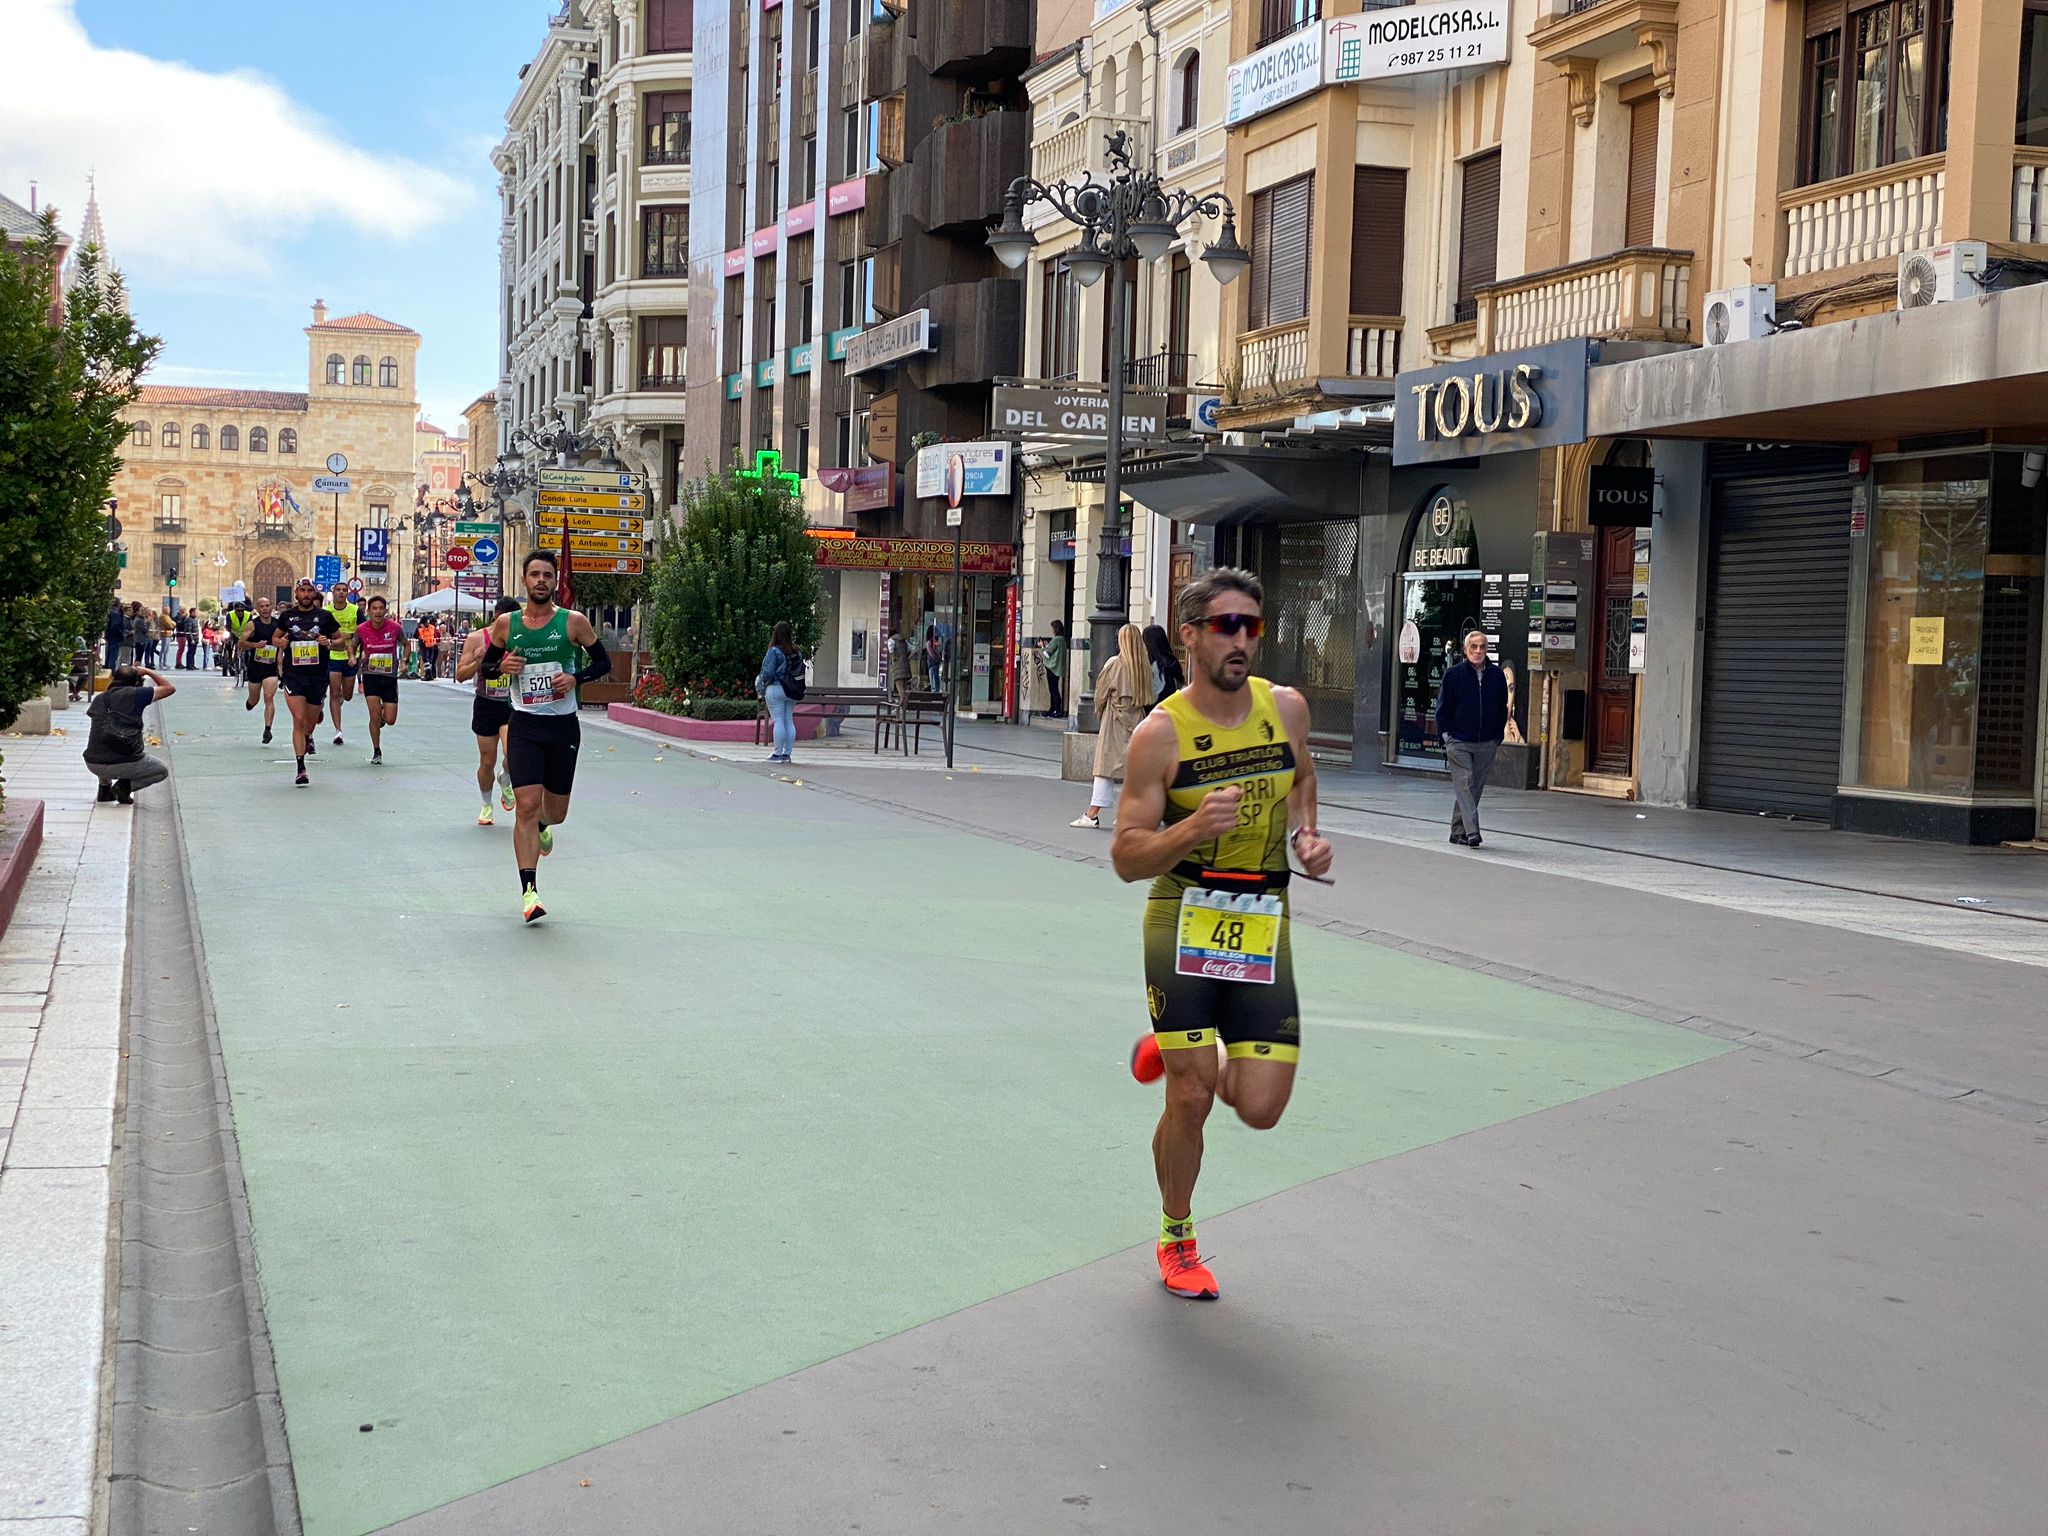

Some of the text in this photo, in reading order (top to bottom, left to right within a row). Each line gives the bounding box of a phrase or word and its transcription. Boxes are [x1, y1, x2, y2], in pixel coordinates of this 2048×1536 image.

[1400, 43, 1482, 66] 987 25 11 21
[1276, 86, 1283, 99] 25
[1284, 83, 1290, 95] 11
[1290, 80, 1298, 92] 21
[1054, 396, 1109, 408] JOYERIA
[1412, 364, 1543, 442] TOUS
[1005, 409, 1156, 433] DEL CAREN
[1596, 489, 1649, 504] TOUS
[1435, 507, 1448, 526] BE
[364, 529, 377, 551] P
[578, 539, 608, 547] Antonio
[1051, 530, 1076, 542] ESTRELLA
[816, 539, 990, 555] ROYAL TANDOORI
[1415, 546, 1470, 567] BE BEAUTY
[262, 650, 271, 658] 97
[299, 648, 310, 658] 114
[377, 659, 385, 667] 70
[529, 676, 553, 692] 520
[1192, 758, 1227, 772] CLUB
[1238, 803, 1263, 827] SP
[1211, 920, 1245, 951] 48
